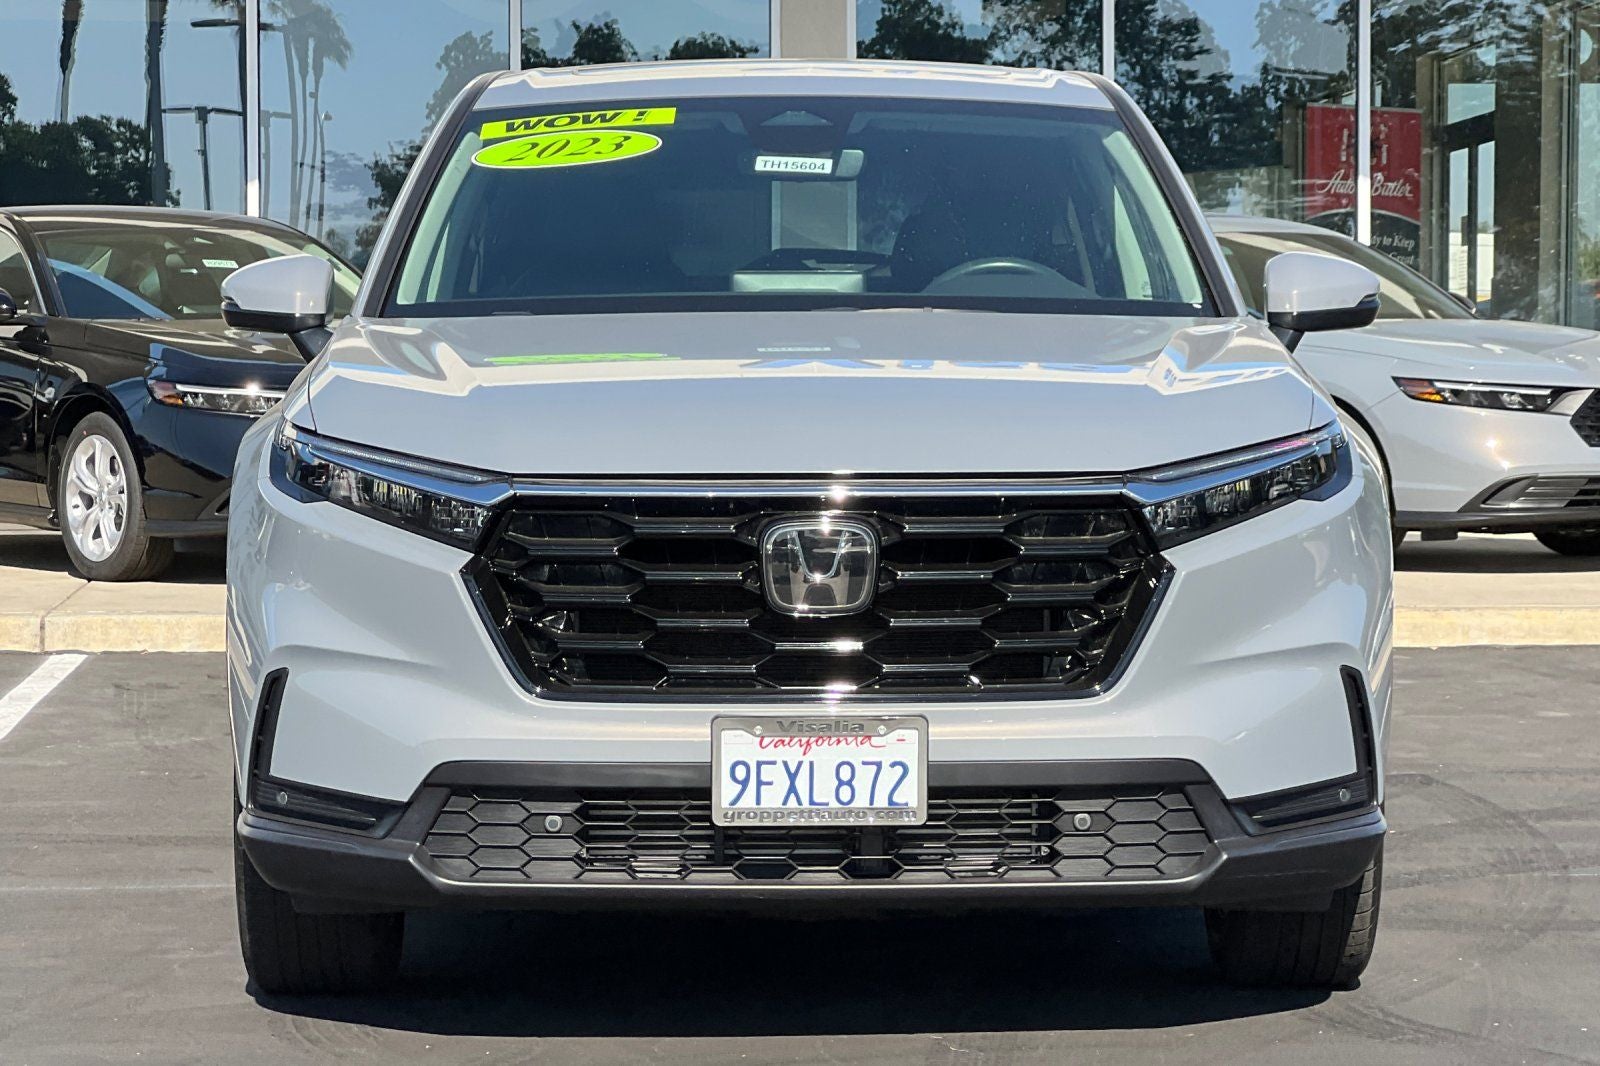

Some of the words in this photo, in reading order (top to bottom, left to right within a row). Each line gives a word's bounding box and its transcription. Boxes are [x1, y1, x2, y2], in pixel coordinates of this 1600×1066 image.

[505, 111, 624, 133] WOW
[502, 135, 632, 163] 2023
[760, 159, 827, 171] TH15604
[1314, 169, 1356, 194] Auto
[1371, 172, 1414, 197] Butler
[776, 720, 866, 734] Visalia
[728, 759, 910, 807] 9FXL872
